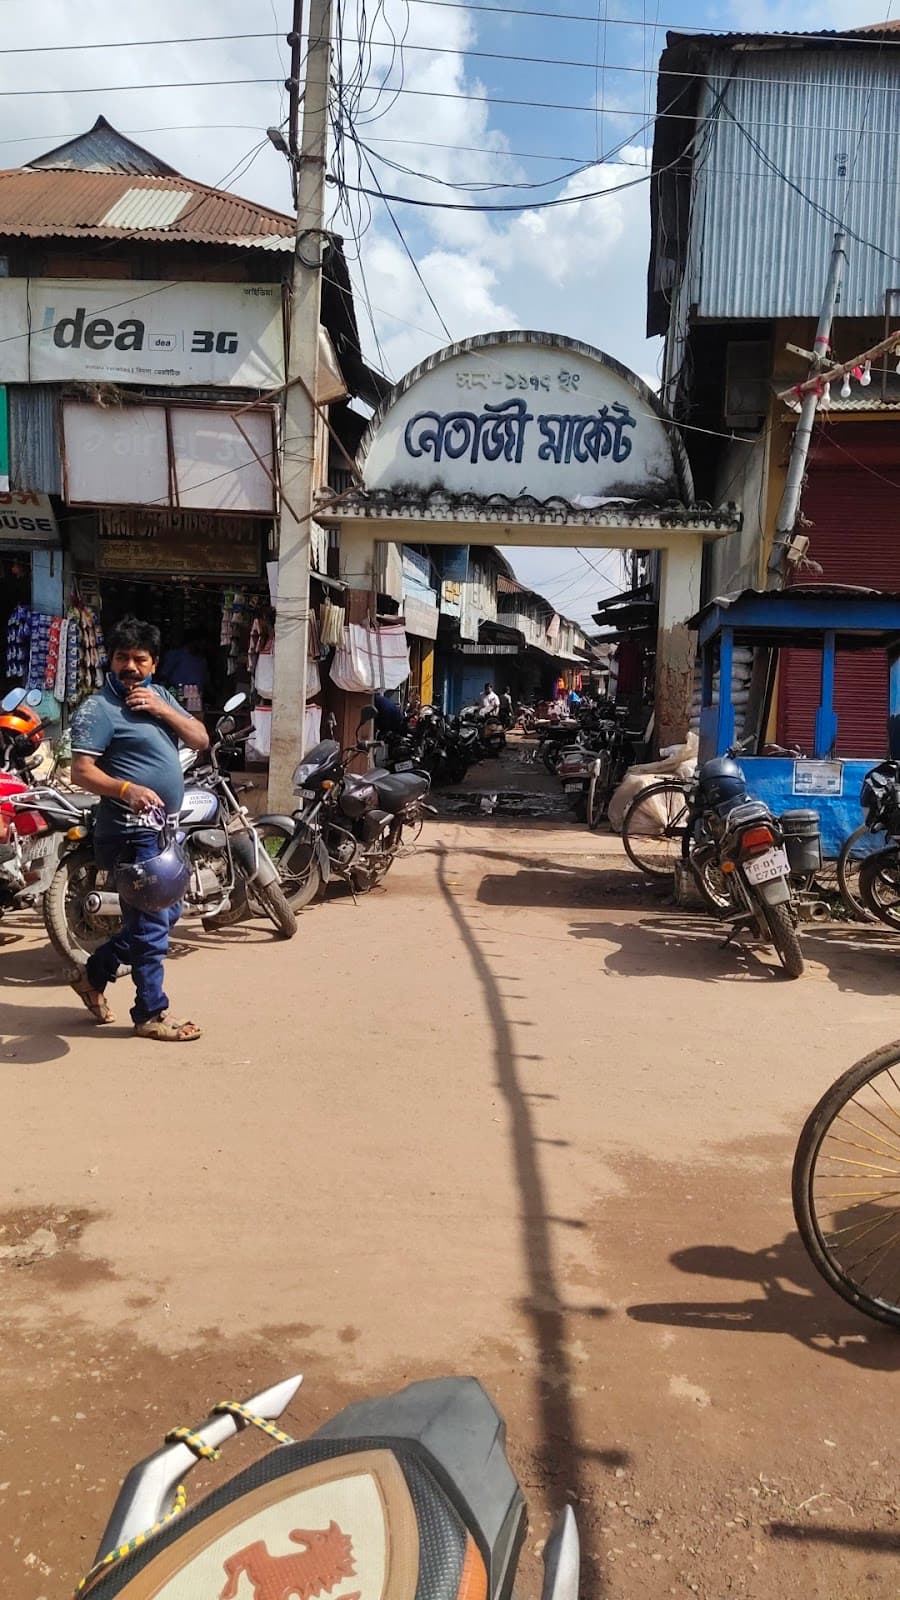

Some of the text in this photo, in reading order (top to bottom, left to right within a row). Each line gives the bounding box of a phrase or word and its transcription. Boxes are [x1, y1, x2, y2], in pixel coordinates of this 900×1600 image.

[190, 330, 239, 354] 3G
[404, 397, 637, 465] নেতাজী মার্কেট
[0, 515, 53, 532] USE
